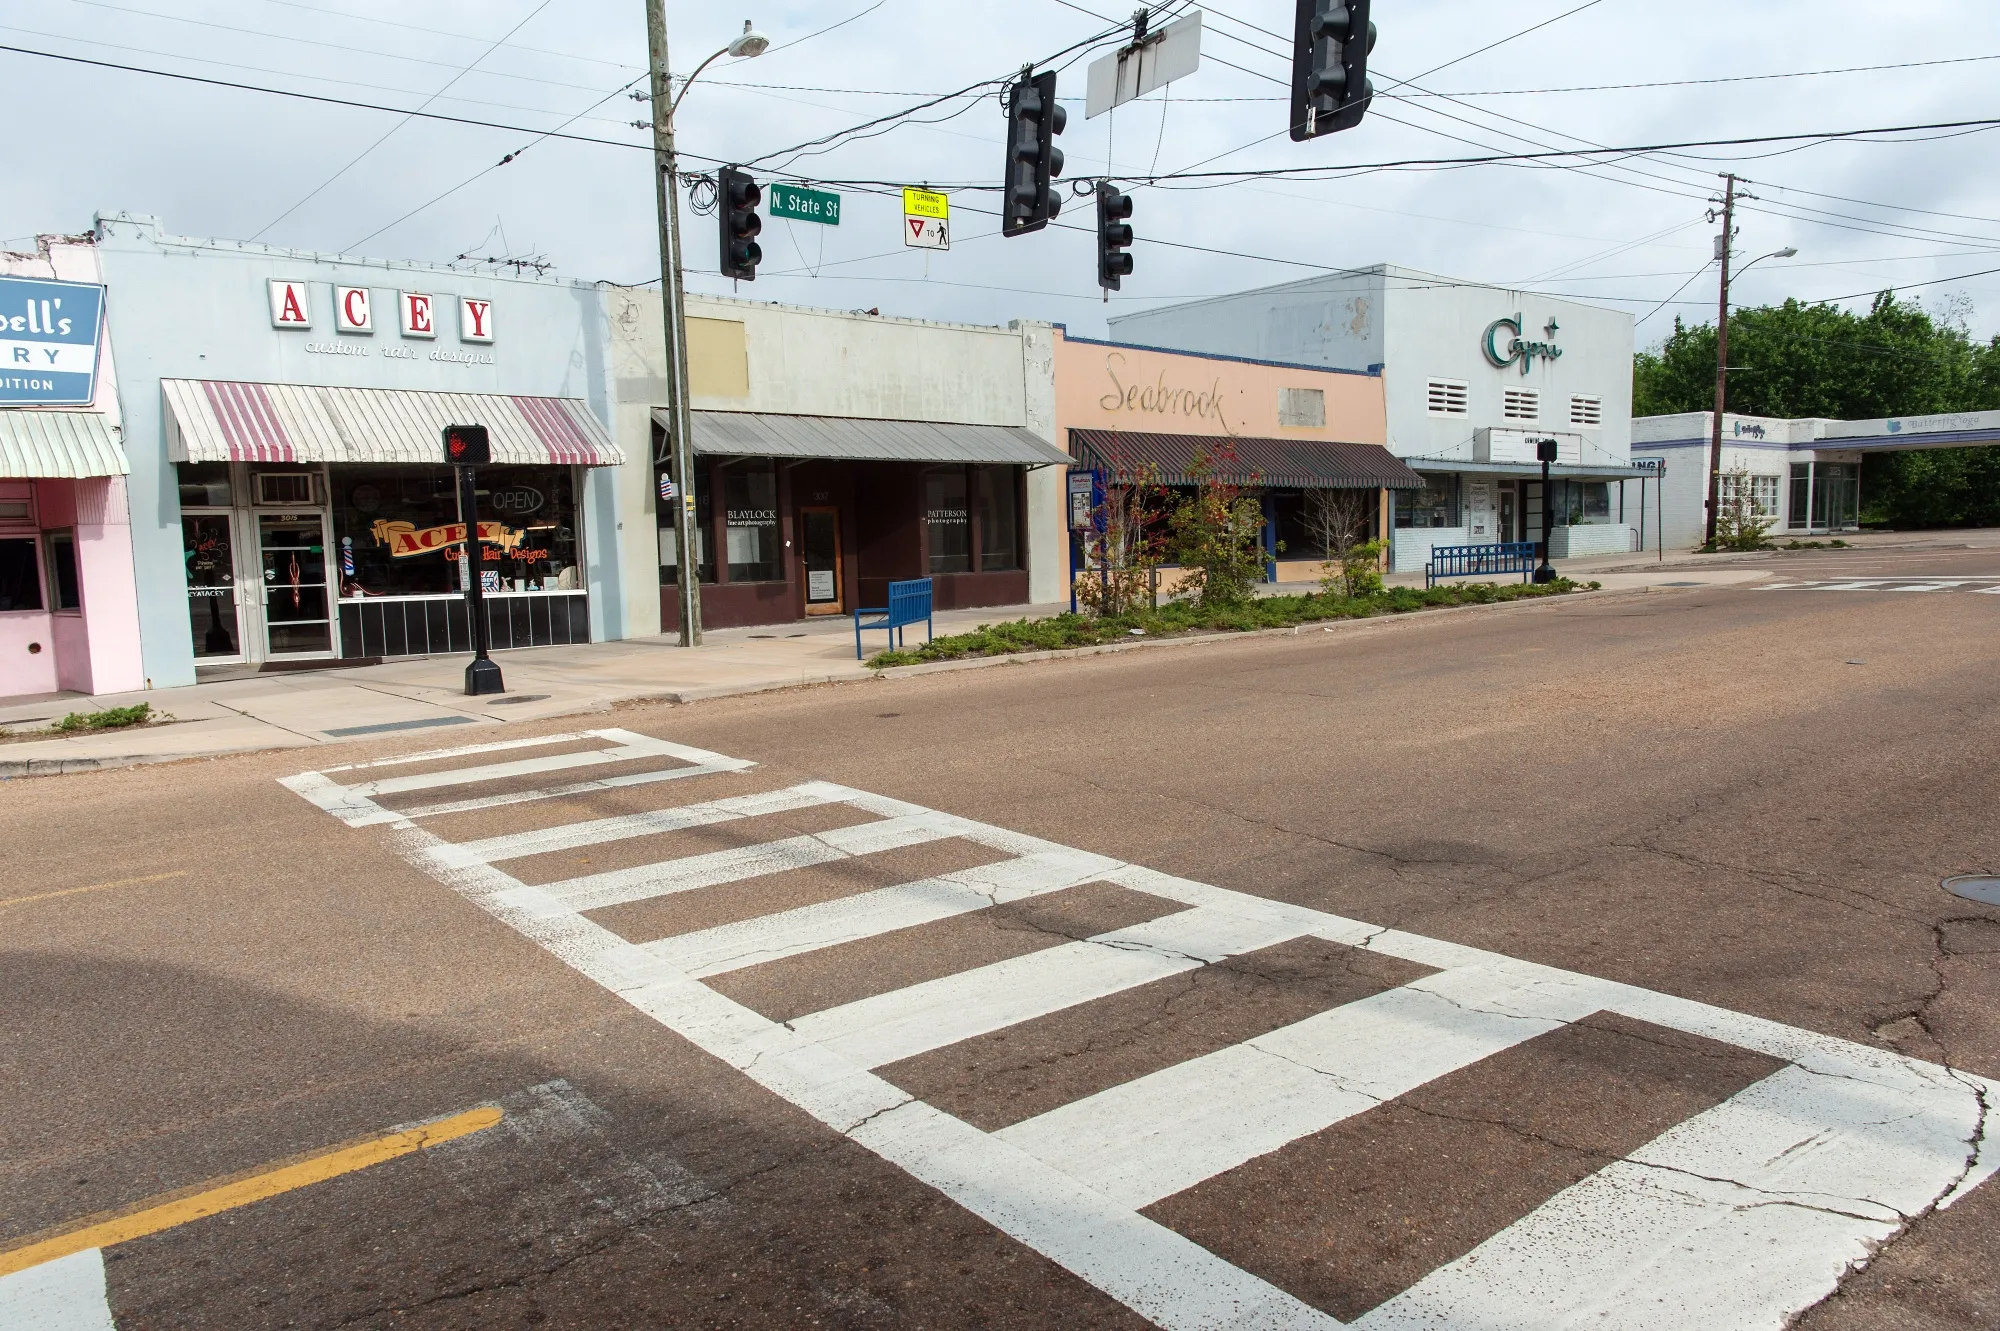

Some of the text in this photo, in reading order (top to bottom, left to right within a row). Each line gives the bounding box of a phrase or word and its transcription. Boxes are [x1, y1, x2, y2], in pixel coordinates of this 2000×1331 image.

[772, 191, 838, 218] N. State St
[913, 192, 940, 203] TURNING
[914, 204, 939, 214] VEHICLES
[926, 229, 935, 237] TO
[279, 284, 489, 337] ACEY
[1481, 312, 1562, 375] Capri
[305, 340, 496, 368] custom hair designs
[1100, 352, 1238, 436] Seabrook
[1907, 415, 1980, 430] Butterfly Yoga
[493, 491, 535, 509] OPEN
[727, 510, 776, 519] BLAYLOCK
[927, 509, 967, 518] PATTERSON
[927, 517, 967, 525] photography
[745, 519, 776, 527] photography
[394, 524, 494, 553] ACEY
[482, 546, 502, 560] Hair
[510, 546, 548, 565] Designs
